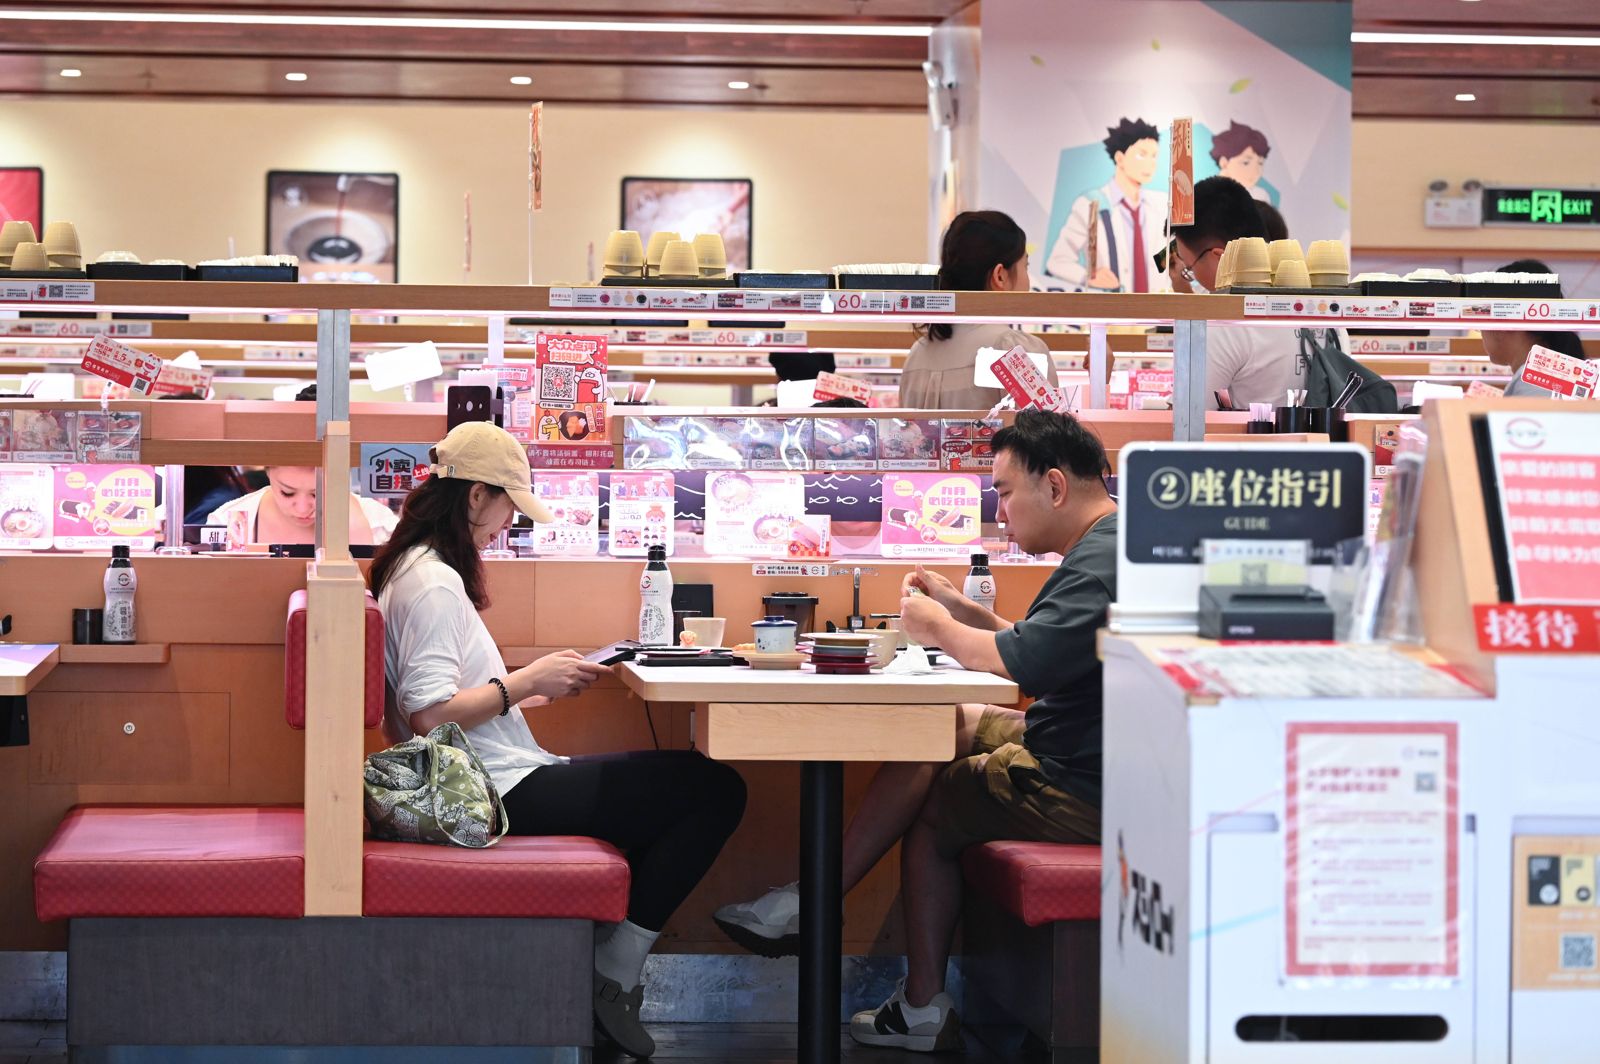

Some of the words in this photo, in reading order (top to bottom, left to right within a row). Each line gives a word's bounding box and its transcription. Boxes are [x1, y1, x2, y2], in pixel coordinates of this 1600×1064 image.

[1563, 198, 1593, 215] EXIT
[837, 294, 861, 309] 60
[1527, 303, 1550, 317] 60
[60, 322, 80, 334] 60
[717, 331, 737, 343] 60
[549, 340, 596, 352] 大众点评
[1361, 339, 1381, 351] 60
[375, 458, 411, 473] 外卖
[375, 474, 412, 490] 自提
[1224, 517, 1270, 530] GUIDE
[1483, 608, 1579, 648] 接待
